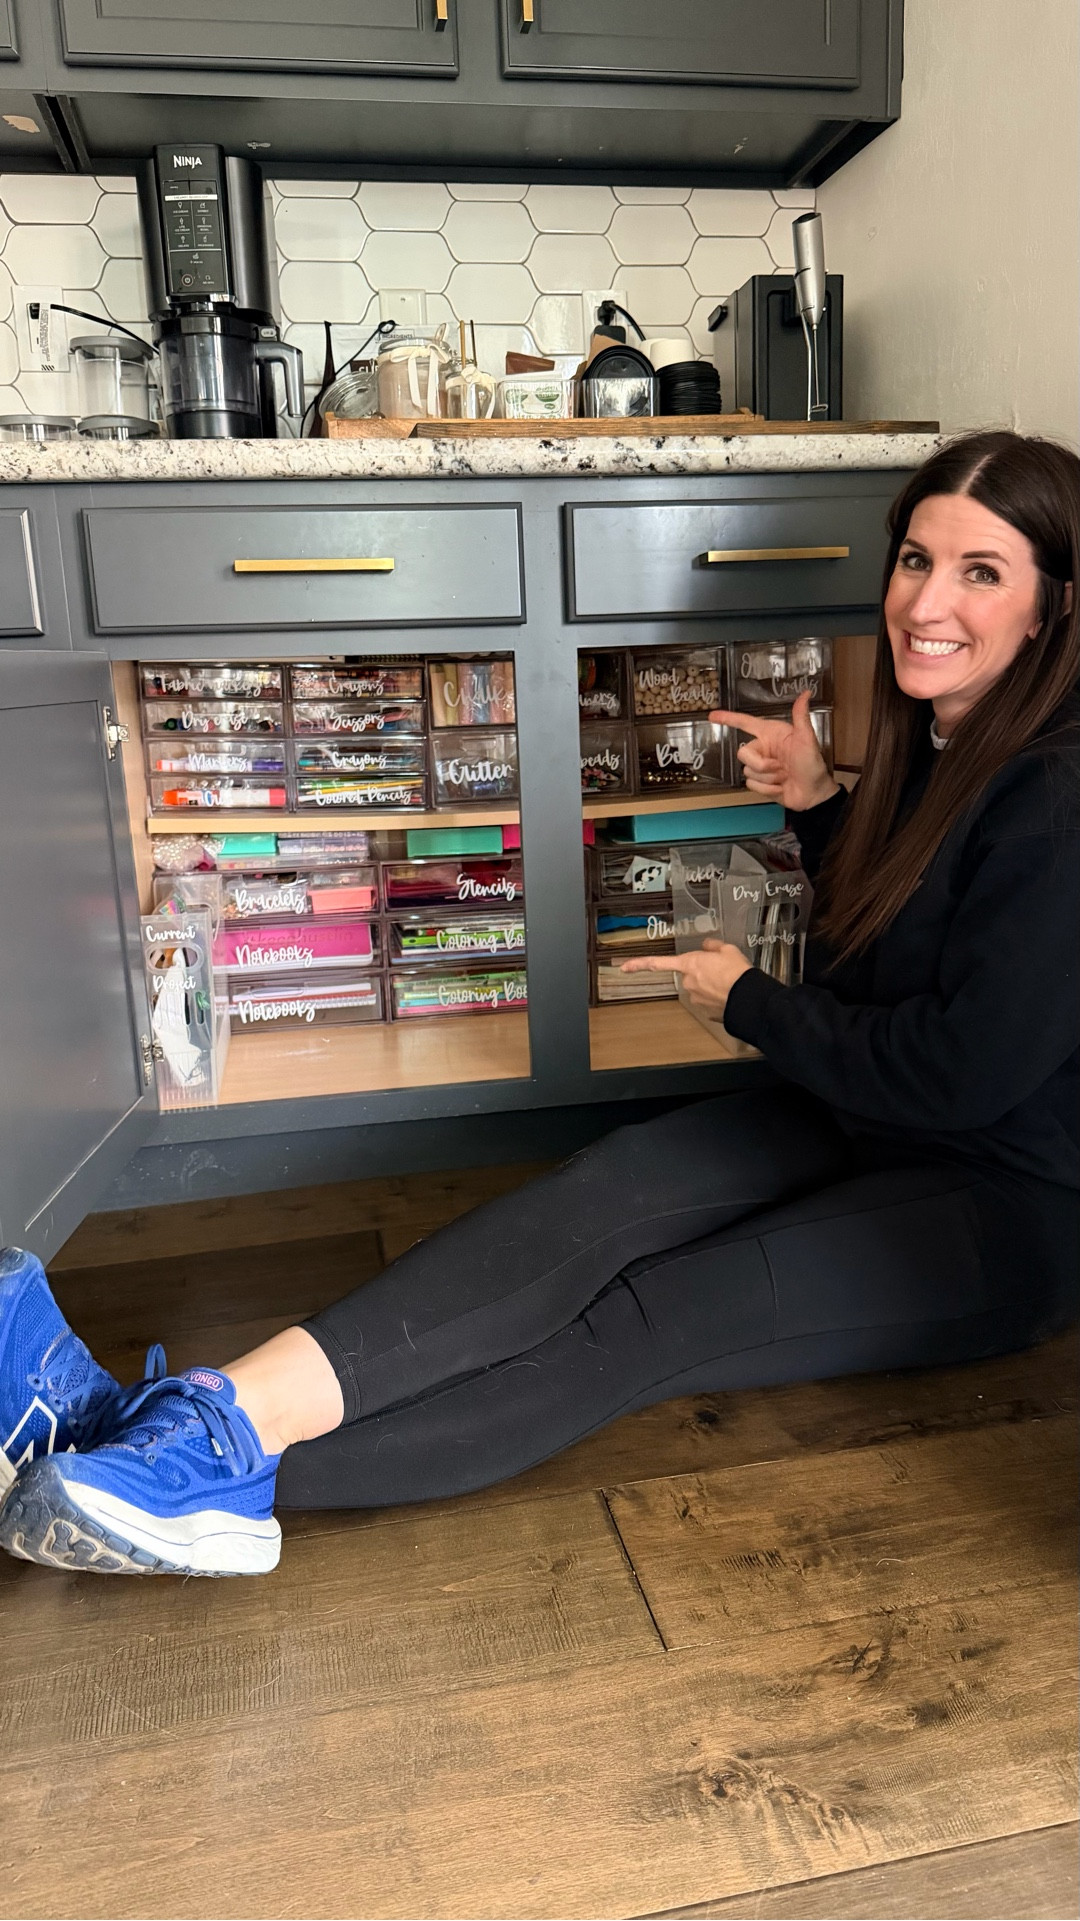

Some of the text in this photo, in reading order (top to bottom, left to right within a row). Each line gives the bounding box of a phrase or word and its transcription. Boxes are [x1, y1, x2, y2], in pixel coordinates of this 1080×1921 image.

[173, 154, 203, 169] NINJA
[328, 671, 385, 697] Crayons
[639, 670, 680, 689] Wood
[671, 684, 716, 705] Beads
[181, 711, 210, 733] Dry
[330, 712, 386, 733] Scissors
[188, 753, 247, 773] Markers
[332, 752, 388, 771] Crayons
[449, 759, 515, 785] Glitter
[315, 786, 412, 806] Colored Pencils
[456, 873, 516, 901] Stencils
[732, 880, 804, 903] Dry Erase
[234, 888, 306, 914] Bracelets
[145, 925, 196, 943] Current
[436, 930, 499, 953] Coloring
[746, 929, 797, 949] Boards
[235, 944, 314, 968] Notebooks
[152, 974, 197, 993] Project
[438, 984, 499, 1008] Coloring
[238, 1000, 317, 1024] Notebooks
[190, 1371, 220, 1388] VONGO
